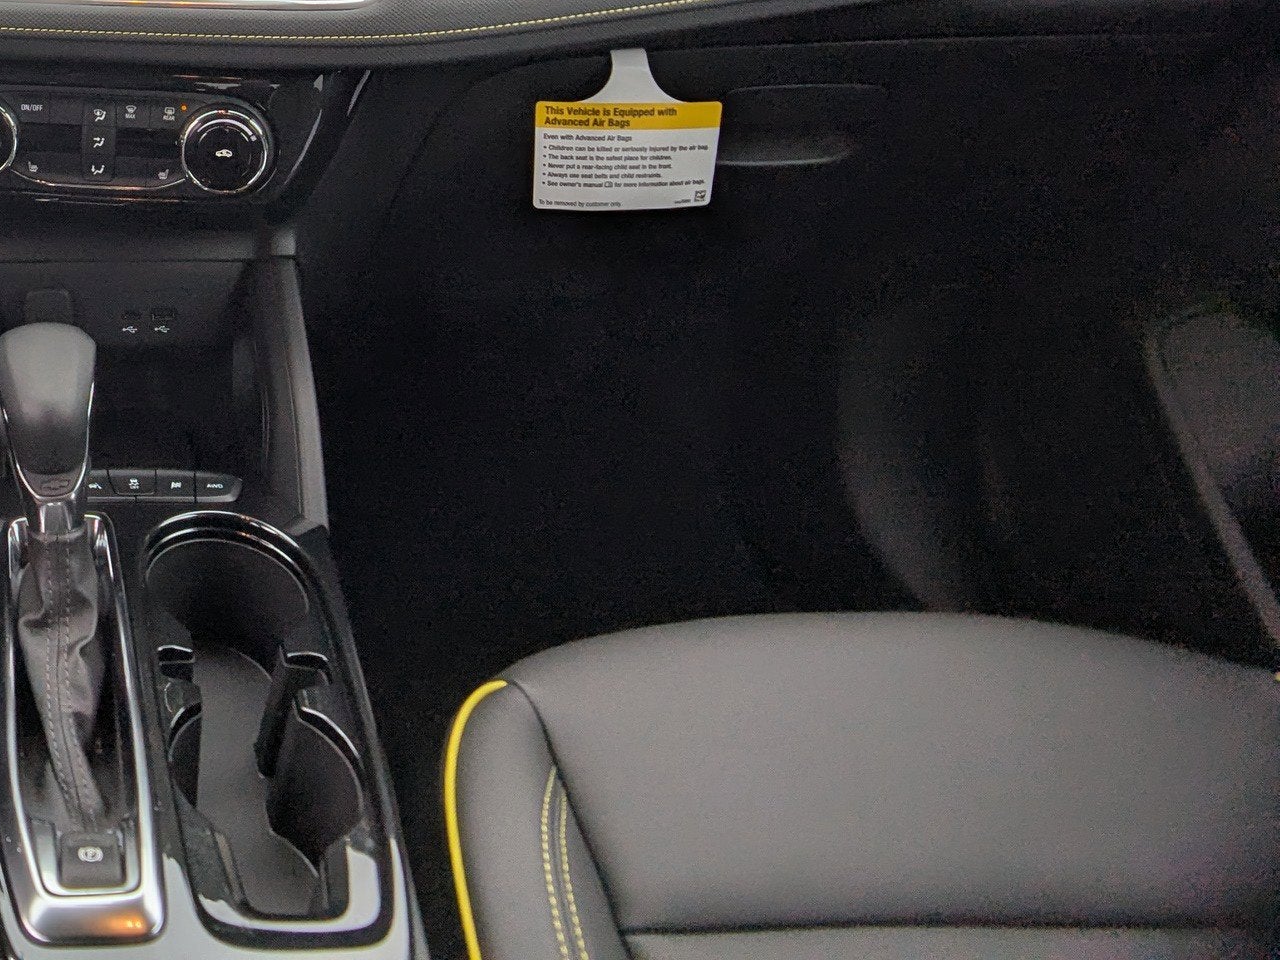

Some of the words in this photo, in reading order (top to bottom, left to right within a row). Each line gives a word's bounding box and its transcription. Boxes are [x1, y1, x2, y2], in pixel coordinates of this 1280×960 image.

[545, 106, 564, 115] This
[567, 107, 600, 116] Vehicle
[614, 108, 654, 117] Equipped
[544, 117, 589, 126] Advanced
[608, 119, 630, 128] Bags
